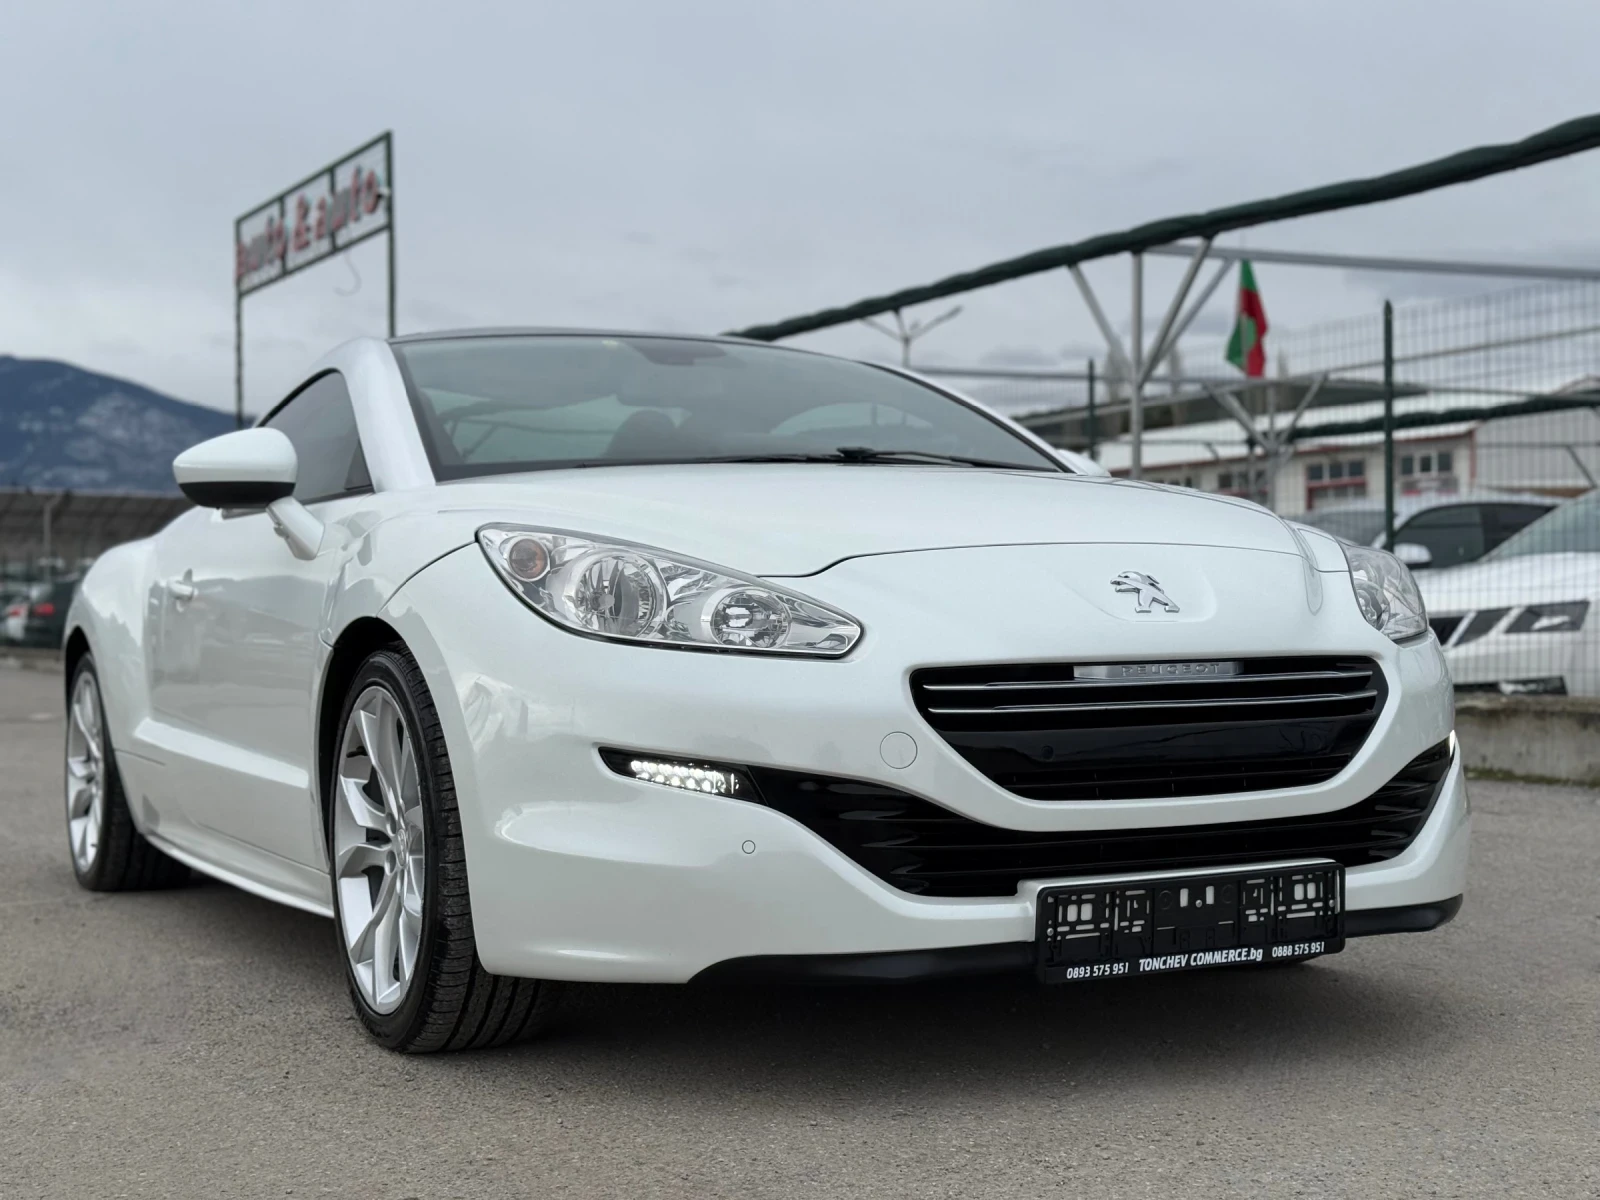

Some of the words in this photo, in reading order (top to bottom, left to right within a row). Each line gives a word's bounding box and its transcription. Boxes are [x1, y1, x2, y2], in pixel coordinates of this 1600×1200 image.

[1122, 664, 1220, 677] PEUGEOT
[1066, 966, 1091, 978] 0893
[1092, 964, 1111, 977] 575
[1112, 962, 1129, 975] 951
[1139, 954, 1189, 971] TONCHEV
[1190, 948, 1264, 966] COMMERCE.bg
[1271, 945, 1293, 958] 0888
[1294, 943, 1309, 955] 575
[1310, 941, 1325, 954] 951
